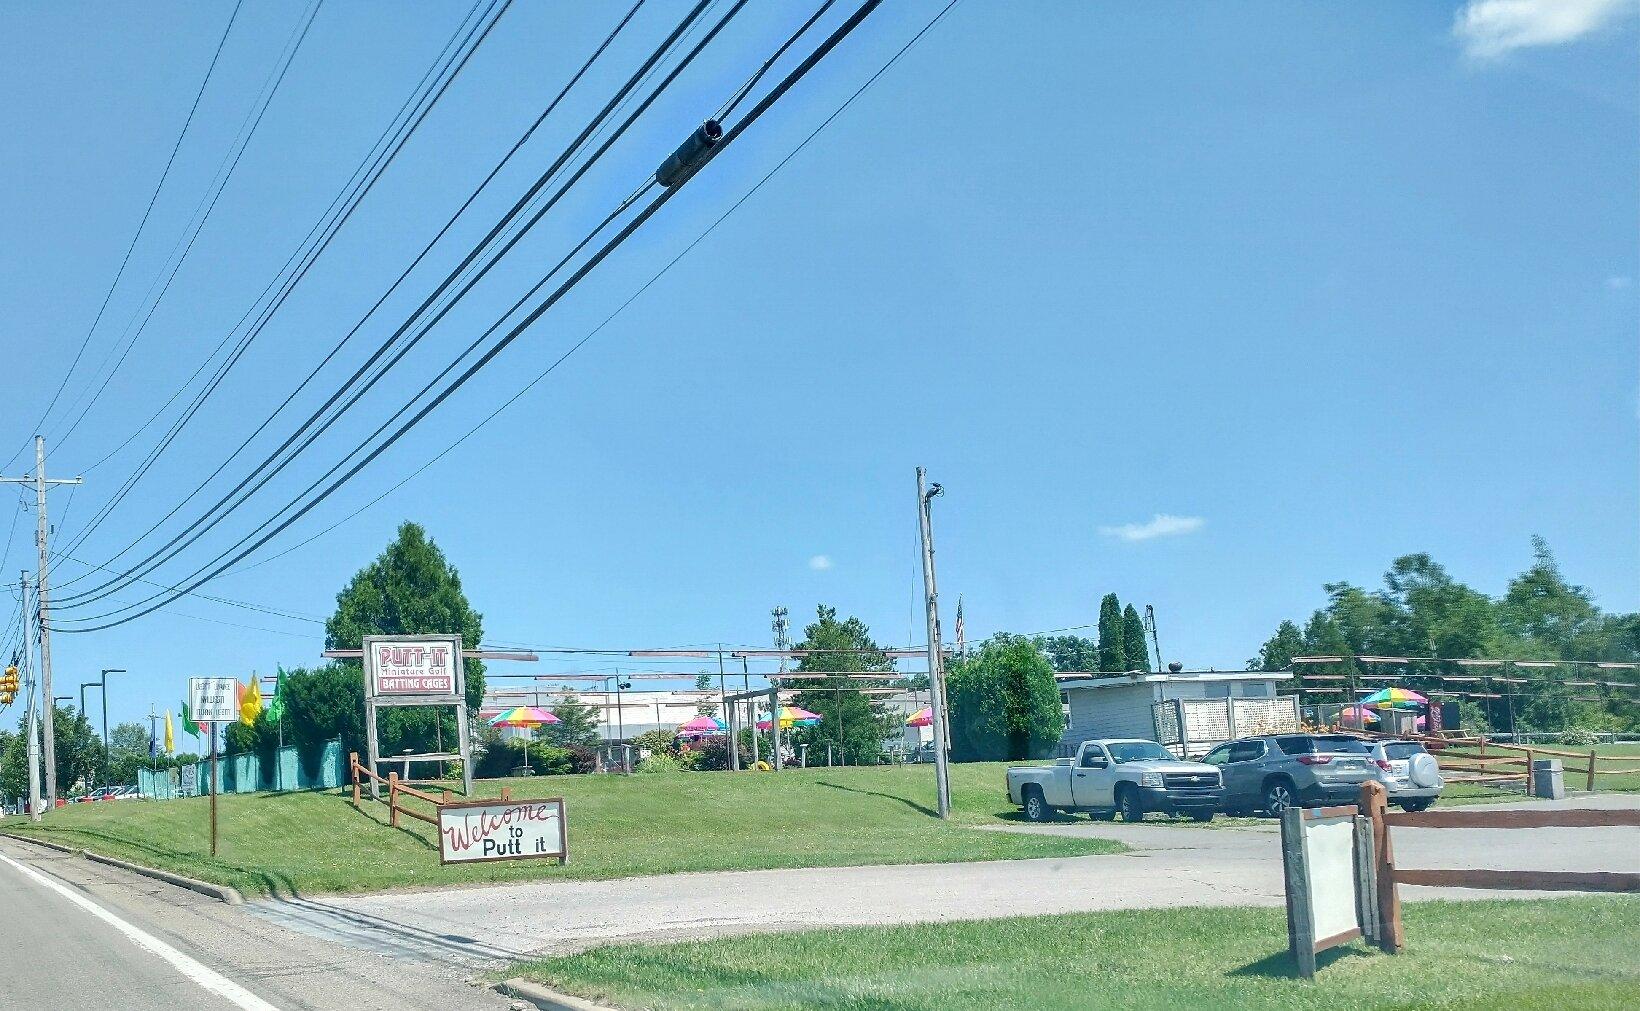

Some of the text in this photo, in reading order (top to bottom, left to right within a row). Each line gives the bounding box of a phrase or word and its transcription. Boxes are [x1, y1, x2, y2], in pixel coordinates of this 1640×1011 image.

[379, 647, 448, 667] PUTT-IT
[428, 667, 447, 675] Golf
[382, 678, 448, 689] BATTING CAGES
[443, 804, 559, 851] Welcome
[509, 825, 524, 838] to
[483, 836, 547, 856] Putt it
